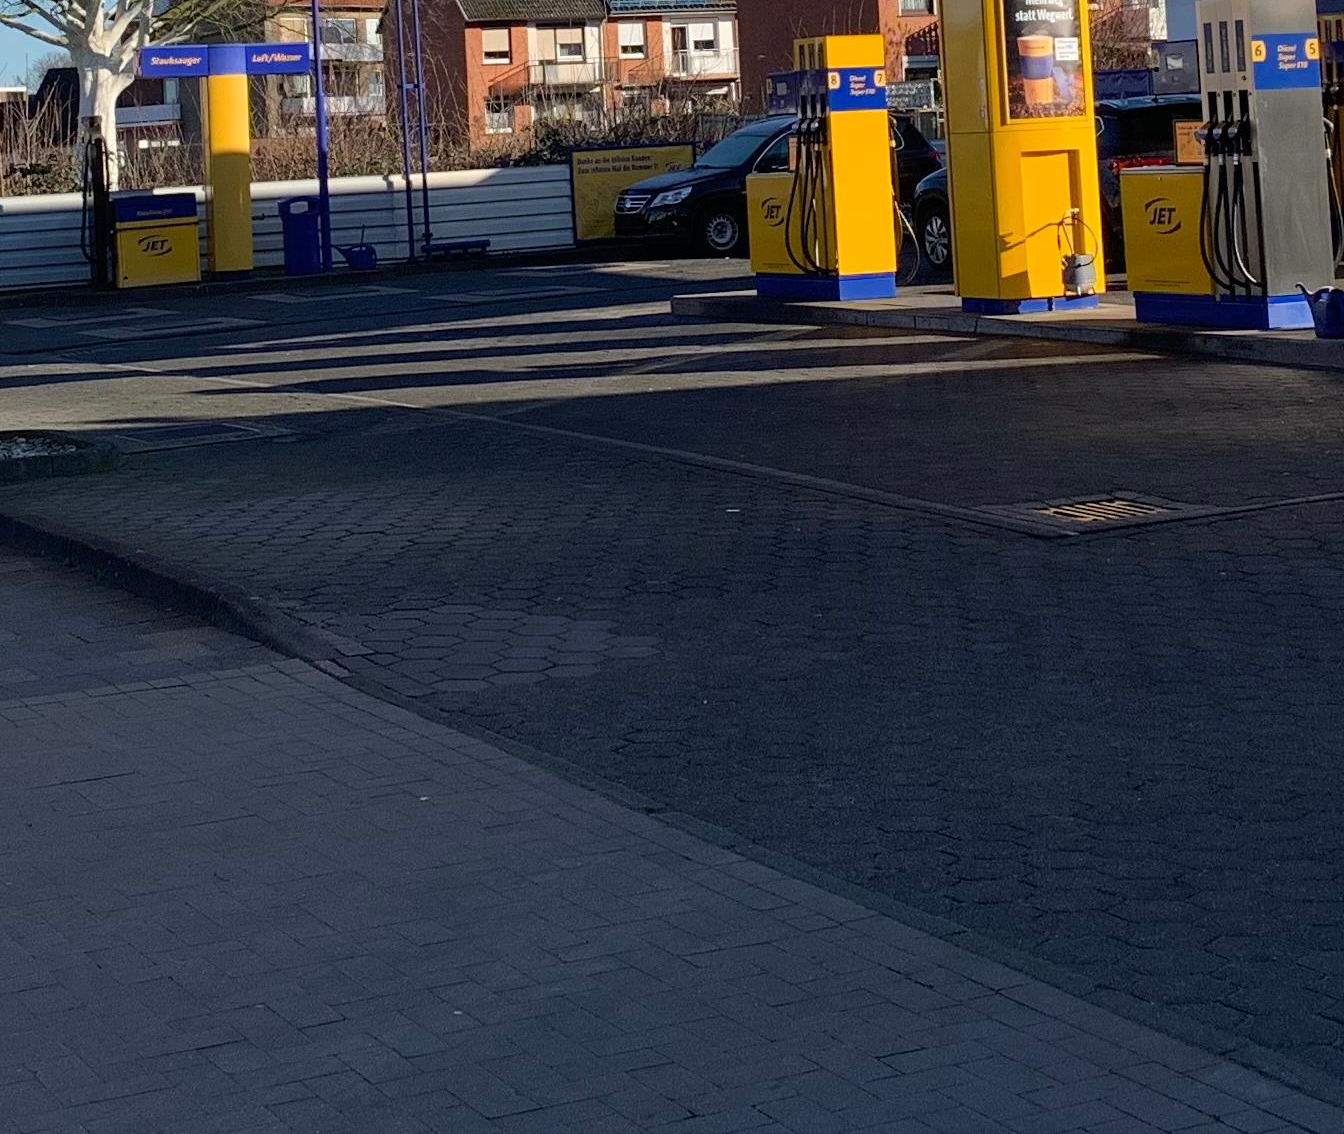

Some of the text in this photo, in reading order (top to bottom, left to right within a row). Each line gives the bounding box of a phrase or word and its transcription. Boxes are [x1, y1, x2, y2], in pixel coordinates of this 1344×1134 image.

[1015, 10, 1036, 21] statt
[1255, 46, 1262, 56] 6
[1309, 43, 1316, 54] 5
[150, 56, 201, 66] Staubsauger
[252, 53, 302, 63] Luft/Wasser
[831, 75, 838, 85] 8
[876, 74, 883, 82] 7
[765, 205, 781, 219] JET
[1149, 208, 1176, 225] JET
[142, 239, 168, 251] JET
